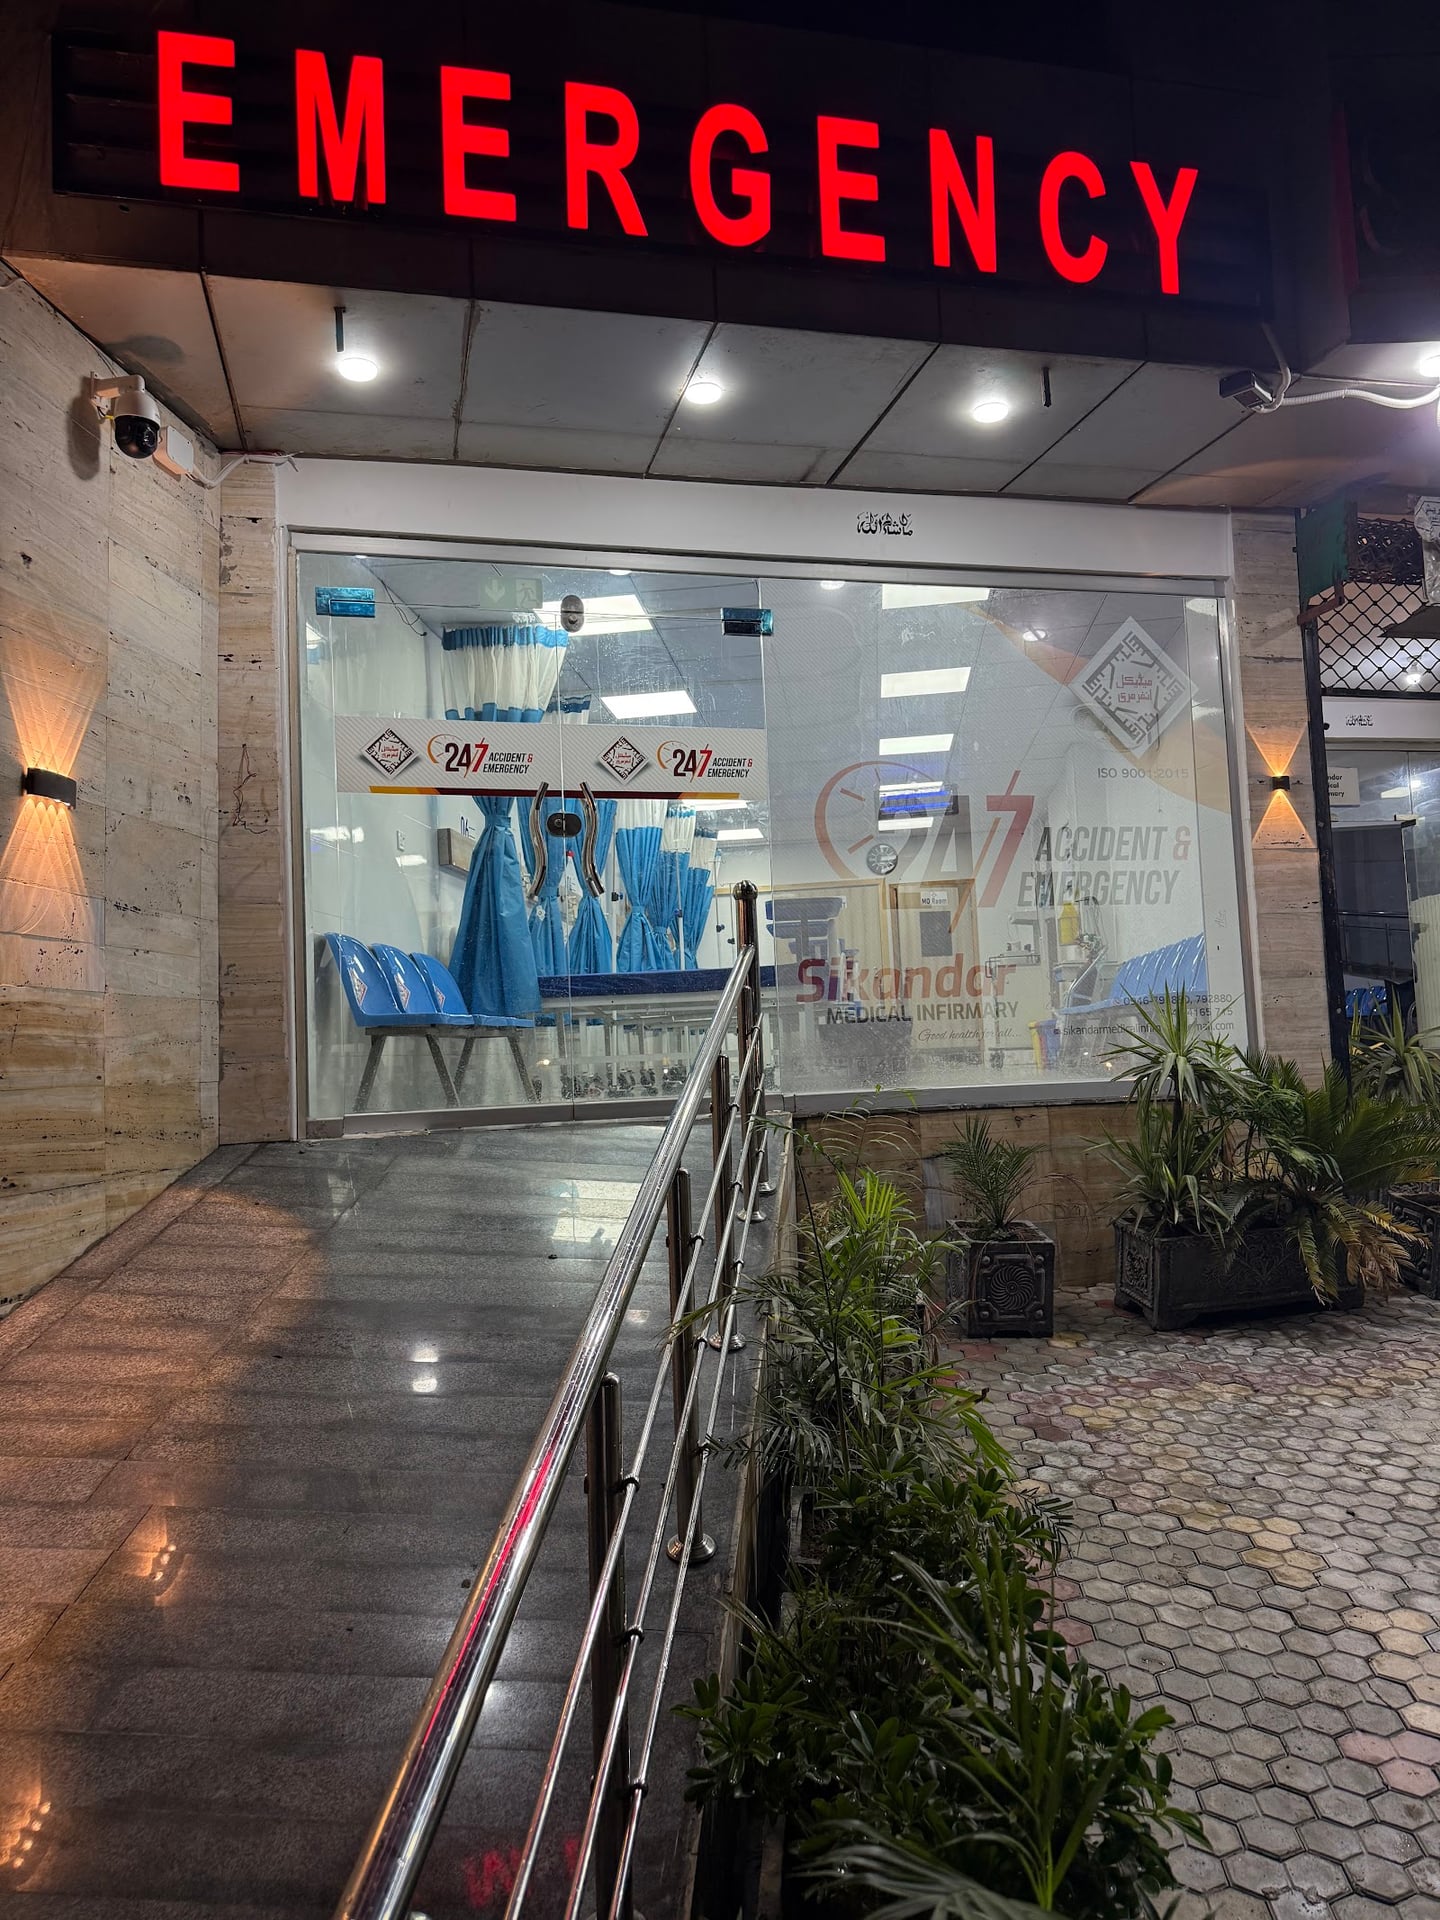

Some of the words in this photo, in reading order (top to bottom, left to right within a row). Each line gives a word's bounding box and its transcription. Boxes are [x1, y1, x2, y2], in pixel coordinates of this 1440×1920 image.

[157, 31, 1199, 295] EMERGENCY
[488, 752, 526, 763] ACCIDENT
[527, 753, 533, 763] &
[712, 757, 747, 767] ACCIDENT
[747, 758, 753, 767] &
[483, 763, 530, 774] EMERGENCY
[707, 767, 750, 778] EMERGENCY
[1097, 767, 1117, 778] ISO
[1121, 767, 1189, 778] 9001:2015
[1035, 826, 1168, 861] ACCIDENT
[1172, 825, 1191, 861] &
[1017, 869, 1181, 908] EMERGENCY
[796, 953, 1017, 1003] Sikandar
[1195, 993, 1233, 1004] 792880
[827, 1004, 911, 1024] MEDICAL
[917, 1002, 1019, 1021] INFIRMARY
[918, 1028, 947, 1042] Good
[949, 1029, 980, 1041] health
